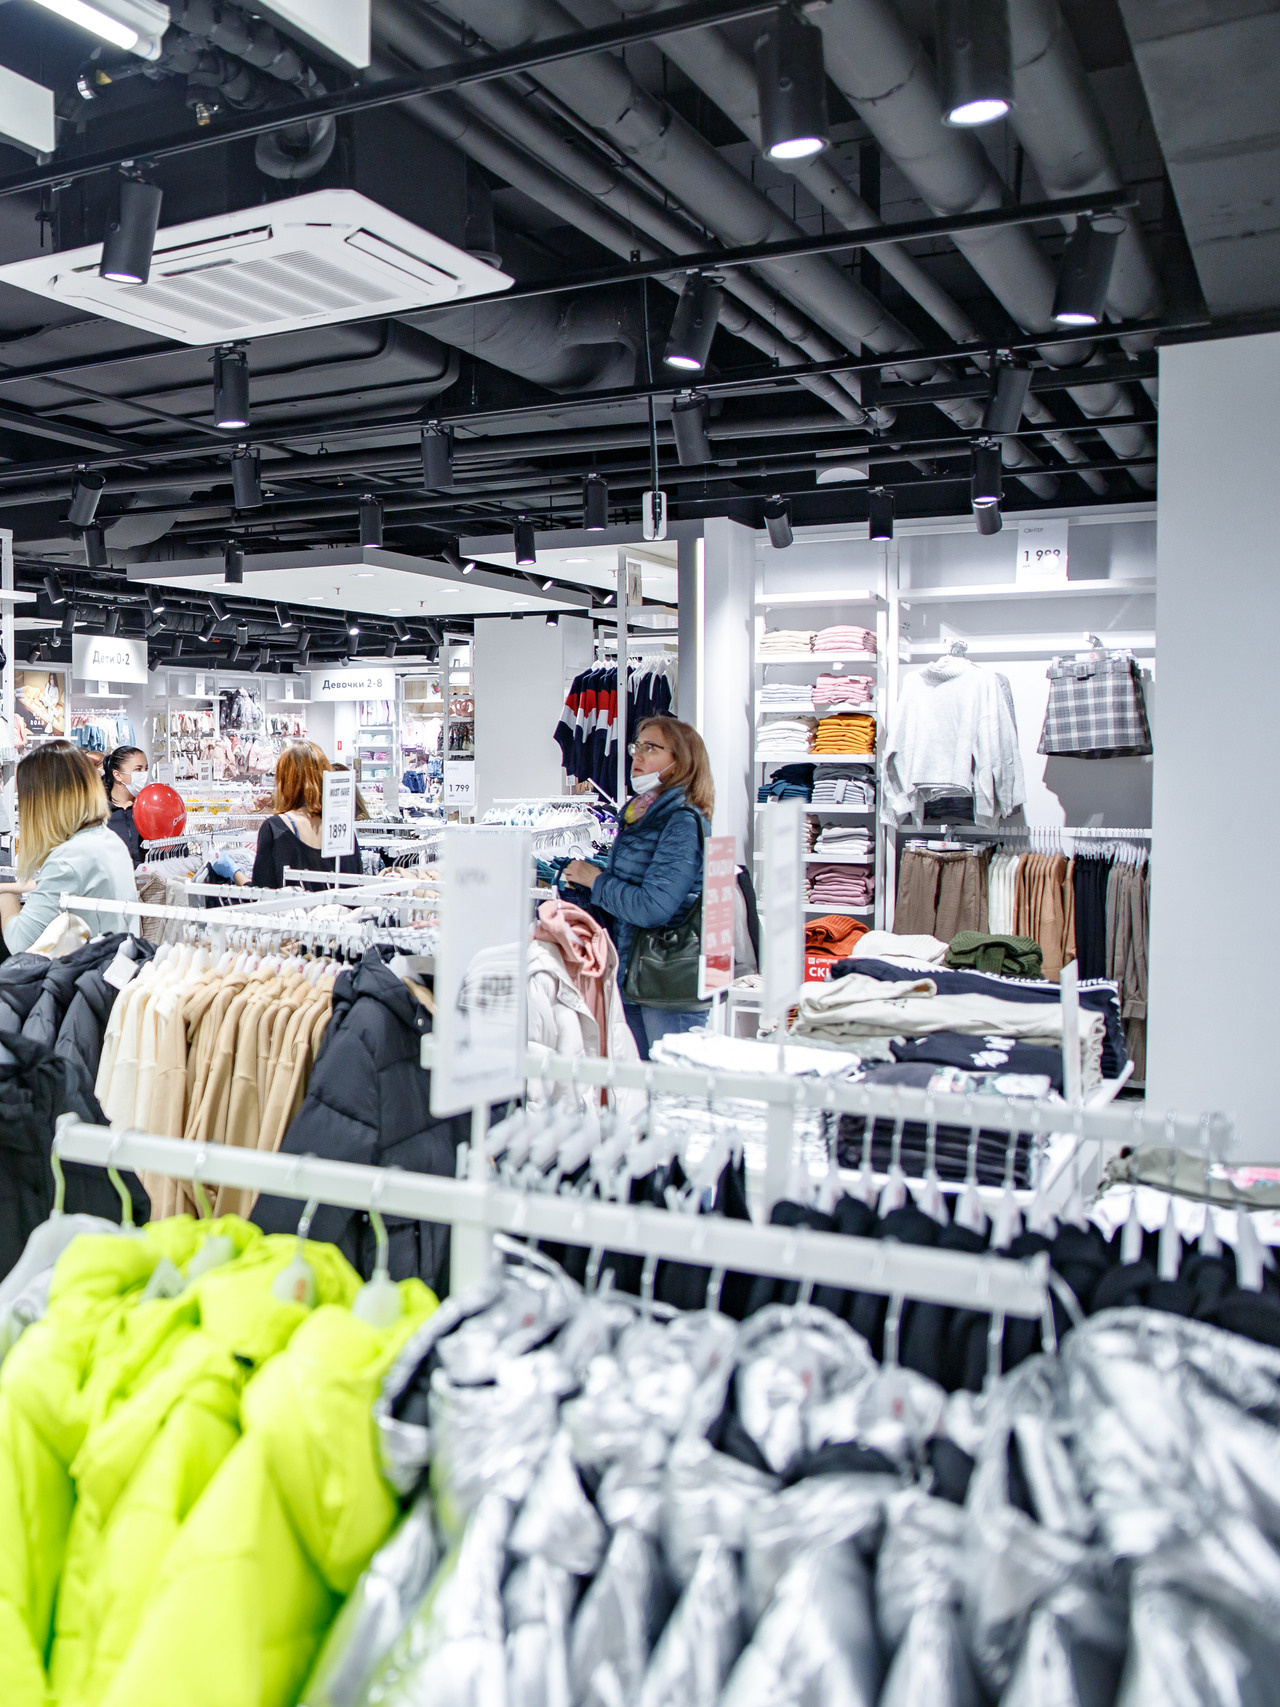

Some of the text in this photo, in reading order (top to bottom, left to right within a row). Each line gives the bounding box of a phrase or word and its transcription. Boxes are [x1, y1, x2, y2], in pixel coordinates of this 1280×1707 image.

[1024, 550, 1029, 561] 1
[93, 650, 130, 665] Дети 0-2
[322, 679, 383, 690] Девочки 2-8
[329, 823, 347, 838] 1899
